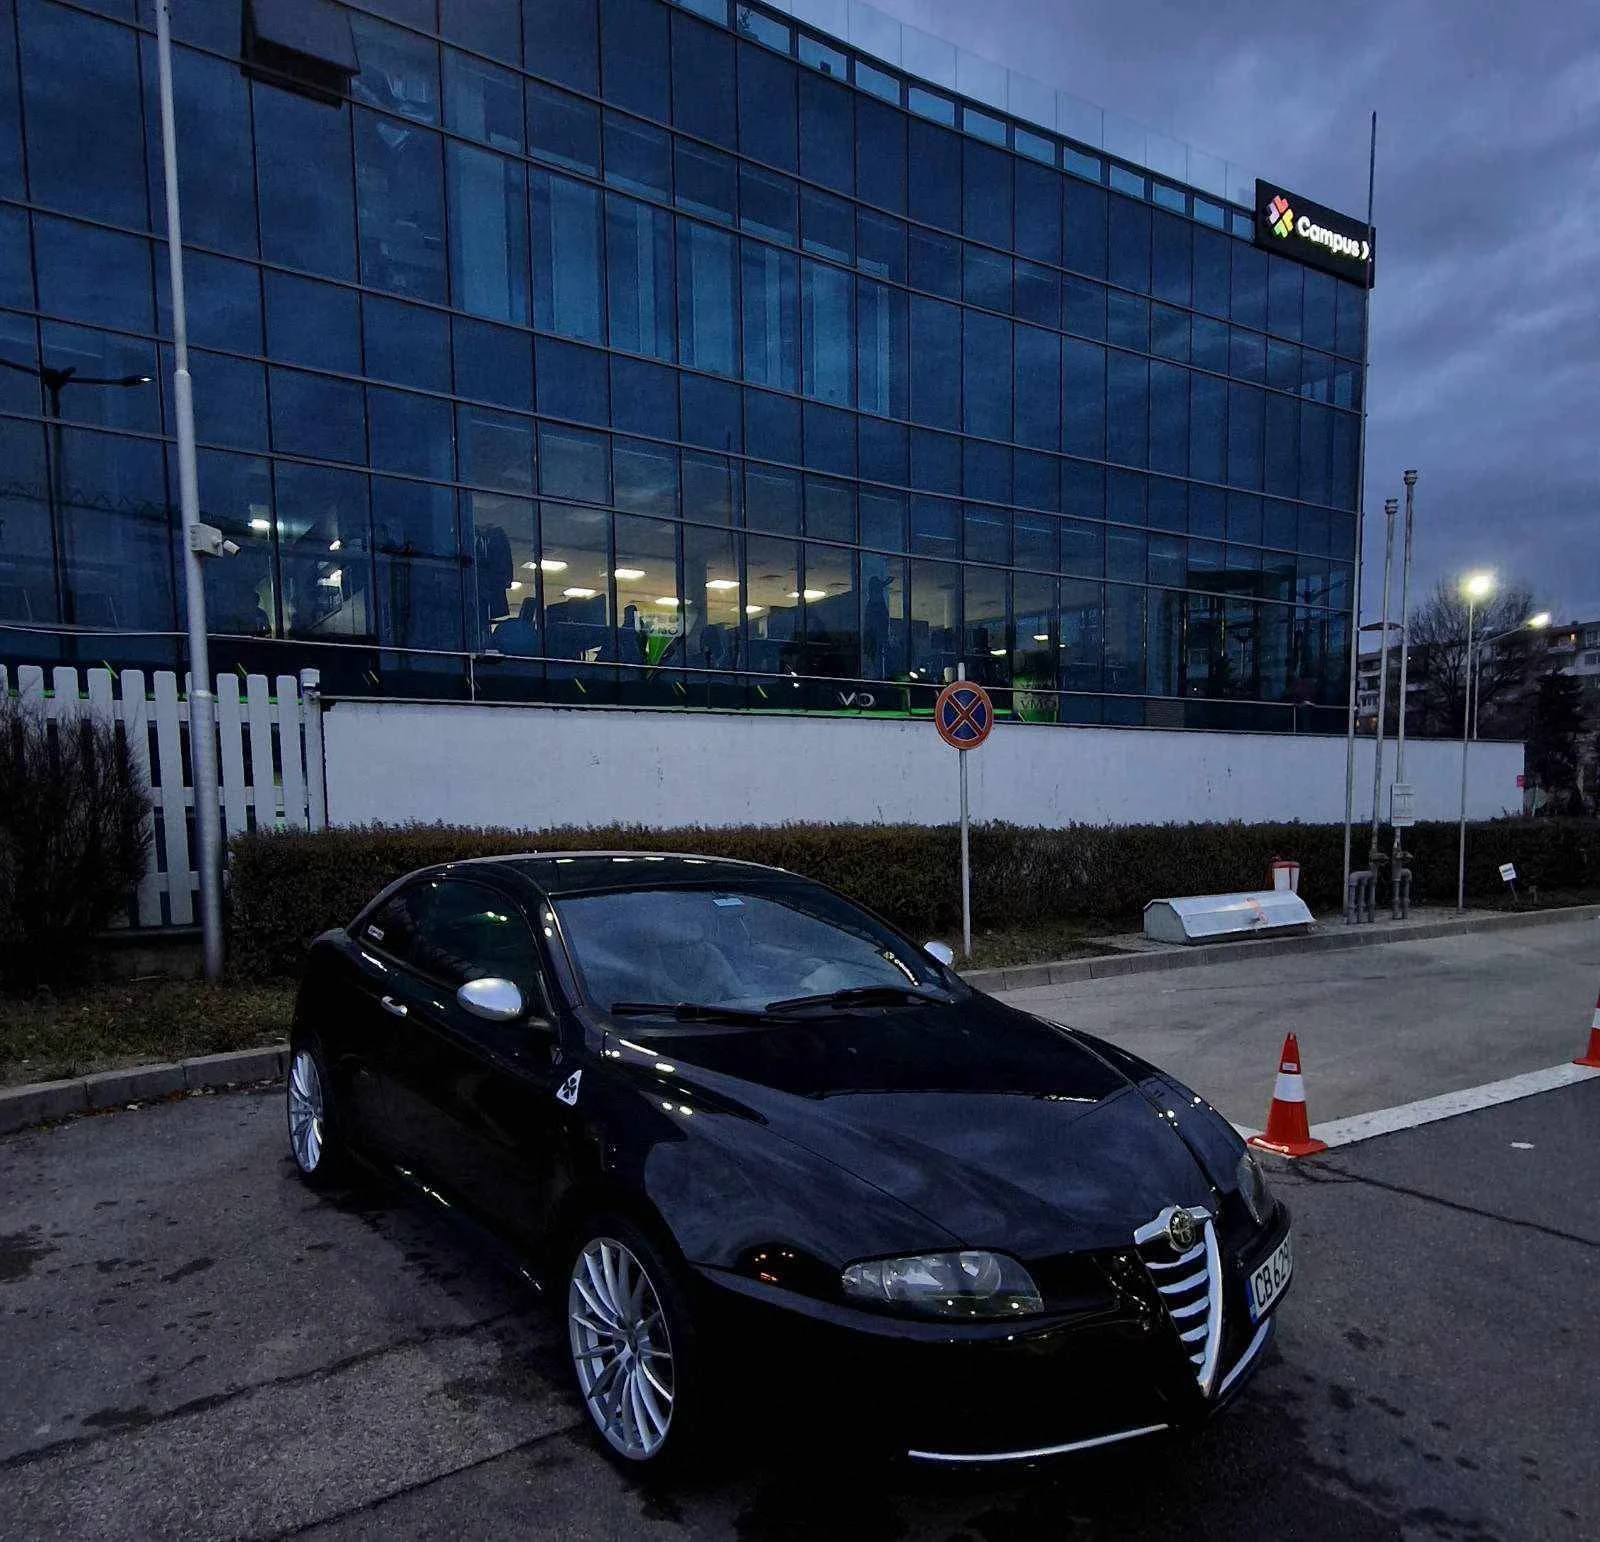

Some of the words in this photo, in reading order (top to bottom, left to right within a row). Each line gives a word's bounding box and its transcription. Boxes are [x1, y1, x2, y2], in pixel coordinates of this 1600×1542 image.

[1296, 215, 1360, 258] Campus
[1255, 1265, 1273, 1308] CB
[1274, 1239, 1290, 1288] 629
